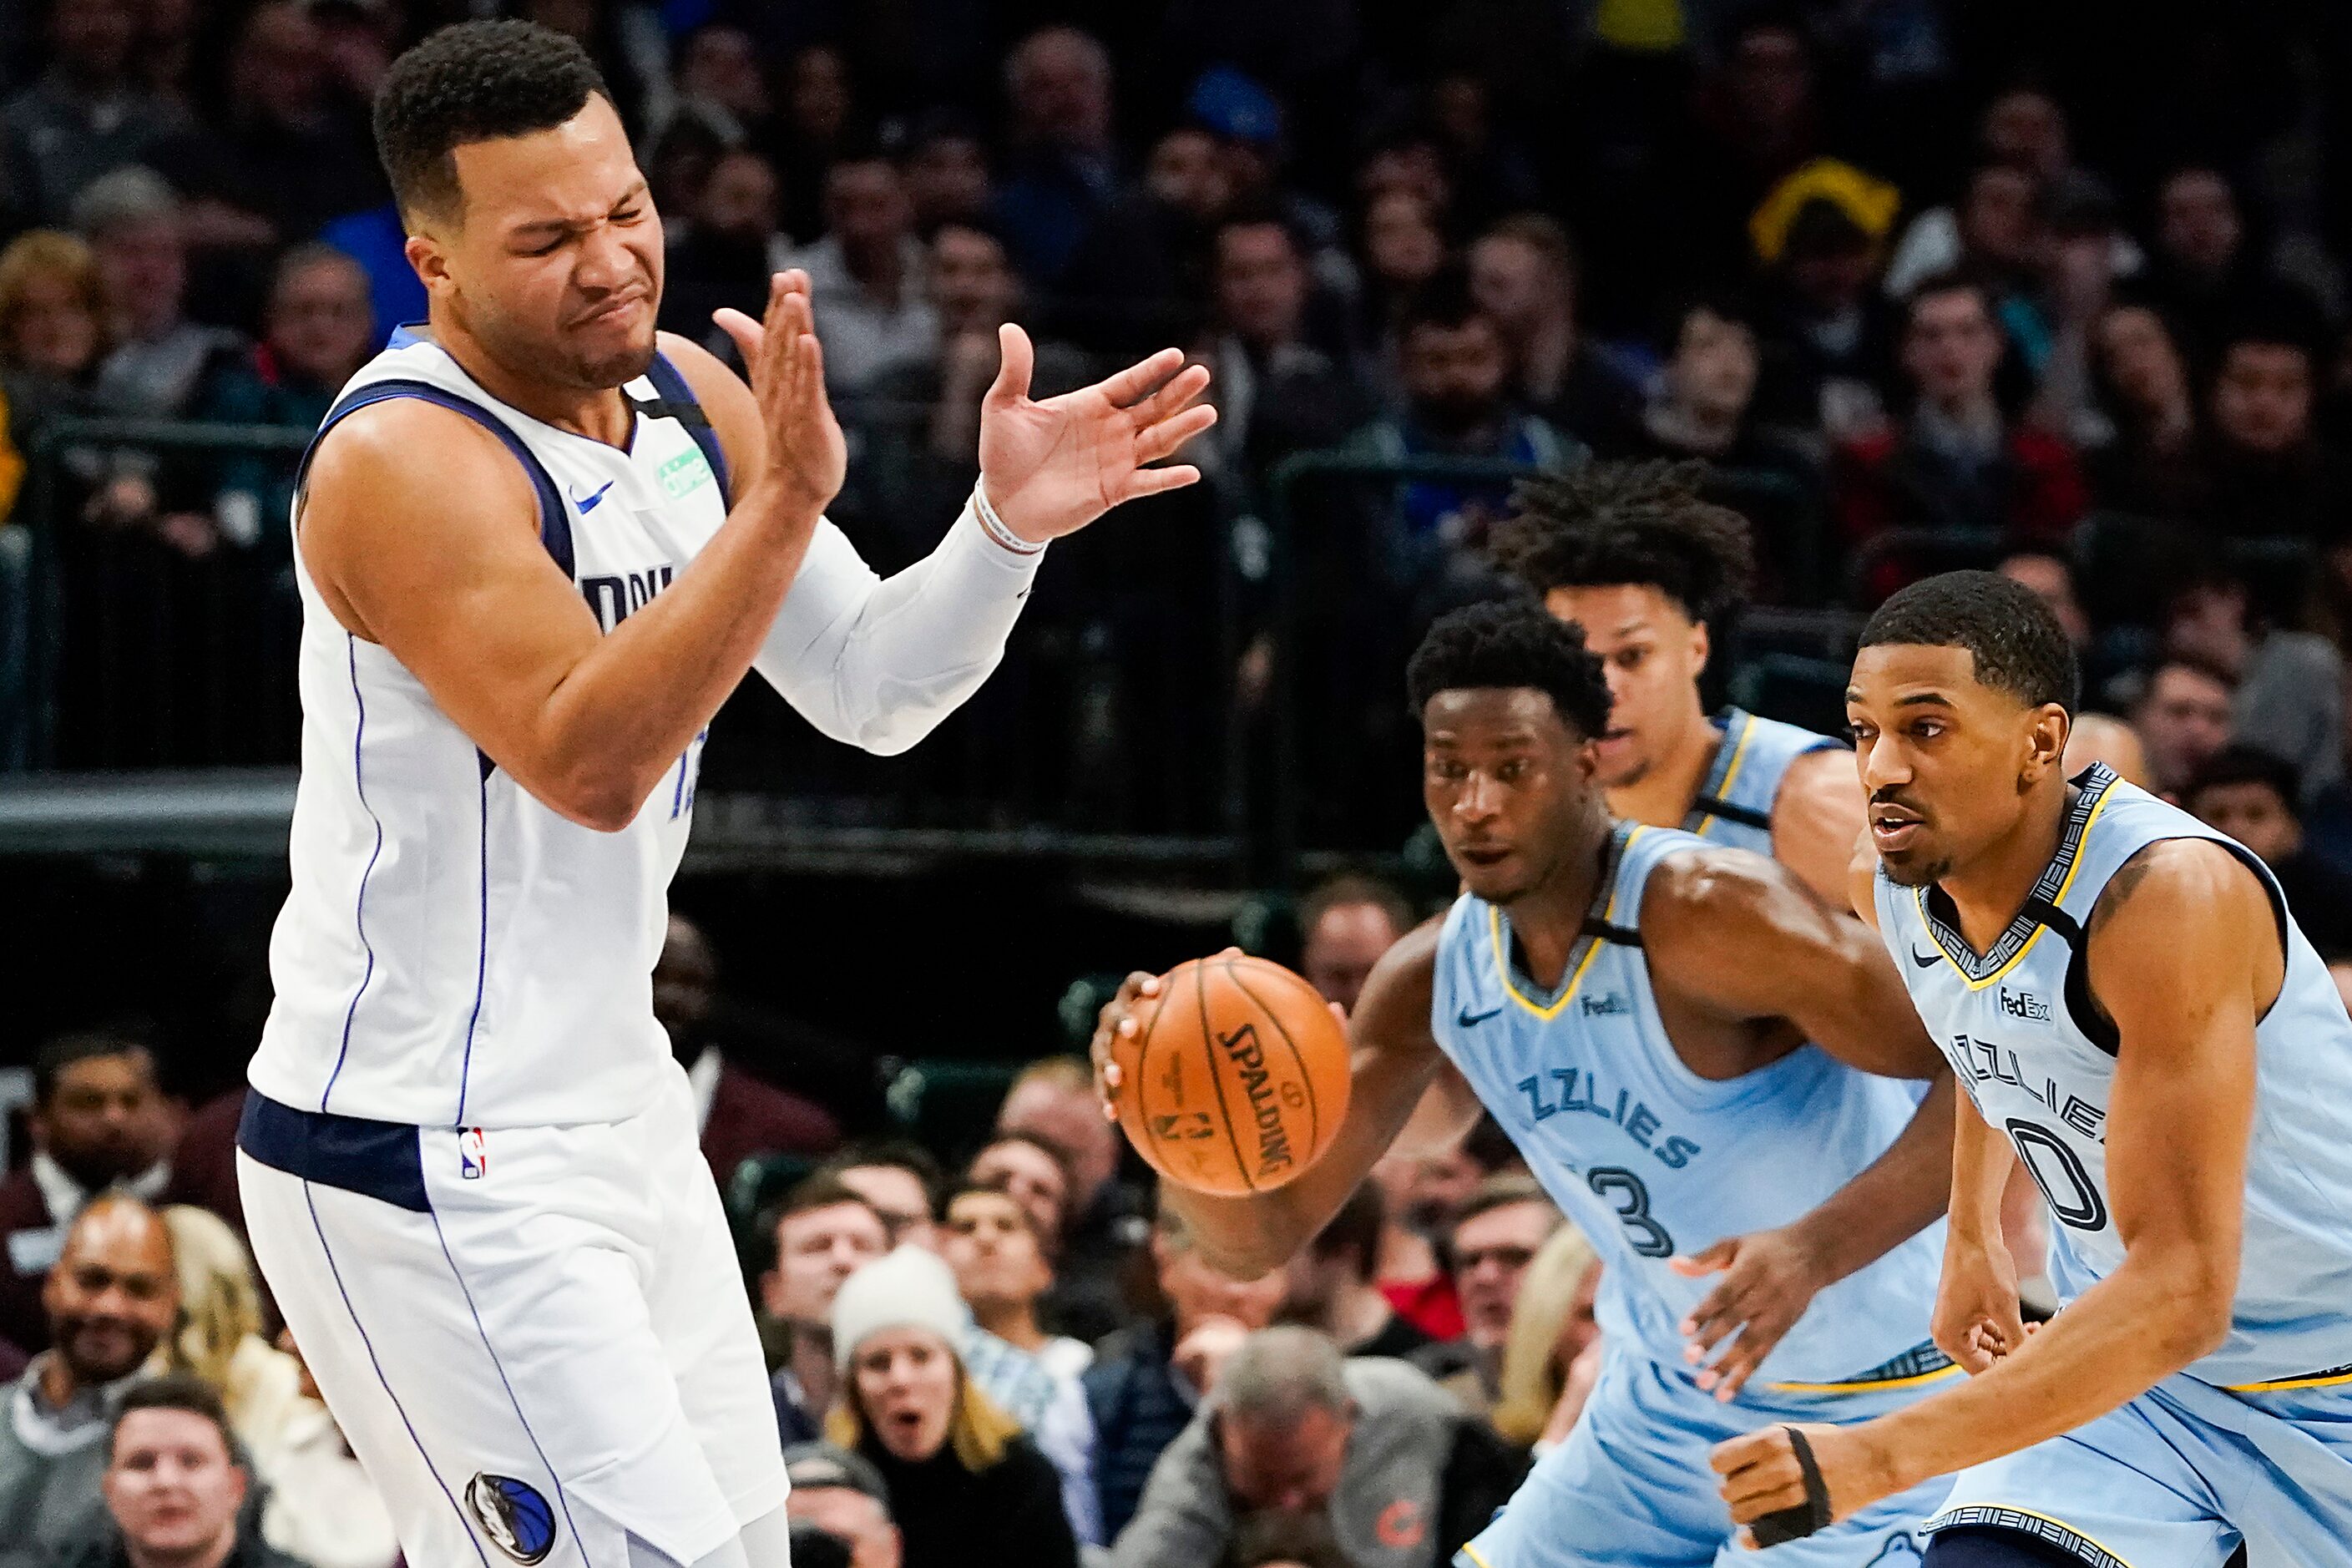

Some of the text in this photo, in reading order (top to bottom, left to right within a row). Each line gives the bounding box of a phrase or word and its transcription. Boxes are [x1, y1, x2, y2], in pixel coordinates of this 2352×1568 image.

[2000, 986, 2051, 1022] FedEx
[1216, 1024, 1294, 1176] SPALDING
[2006, 1117, 2107, 1232] 0
